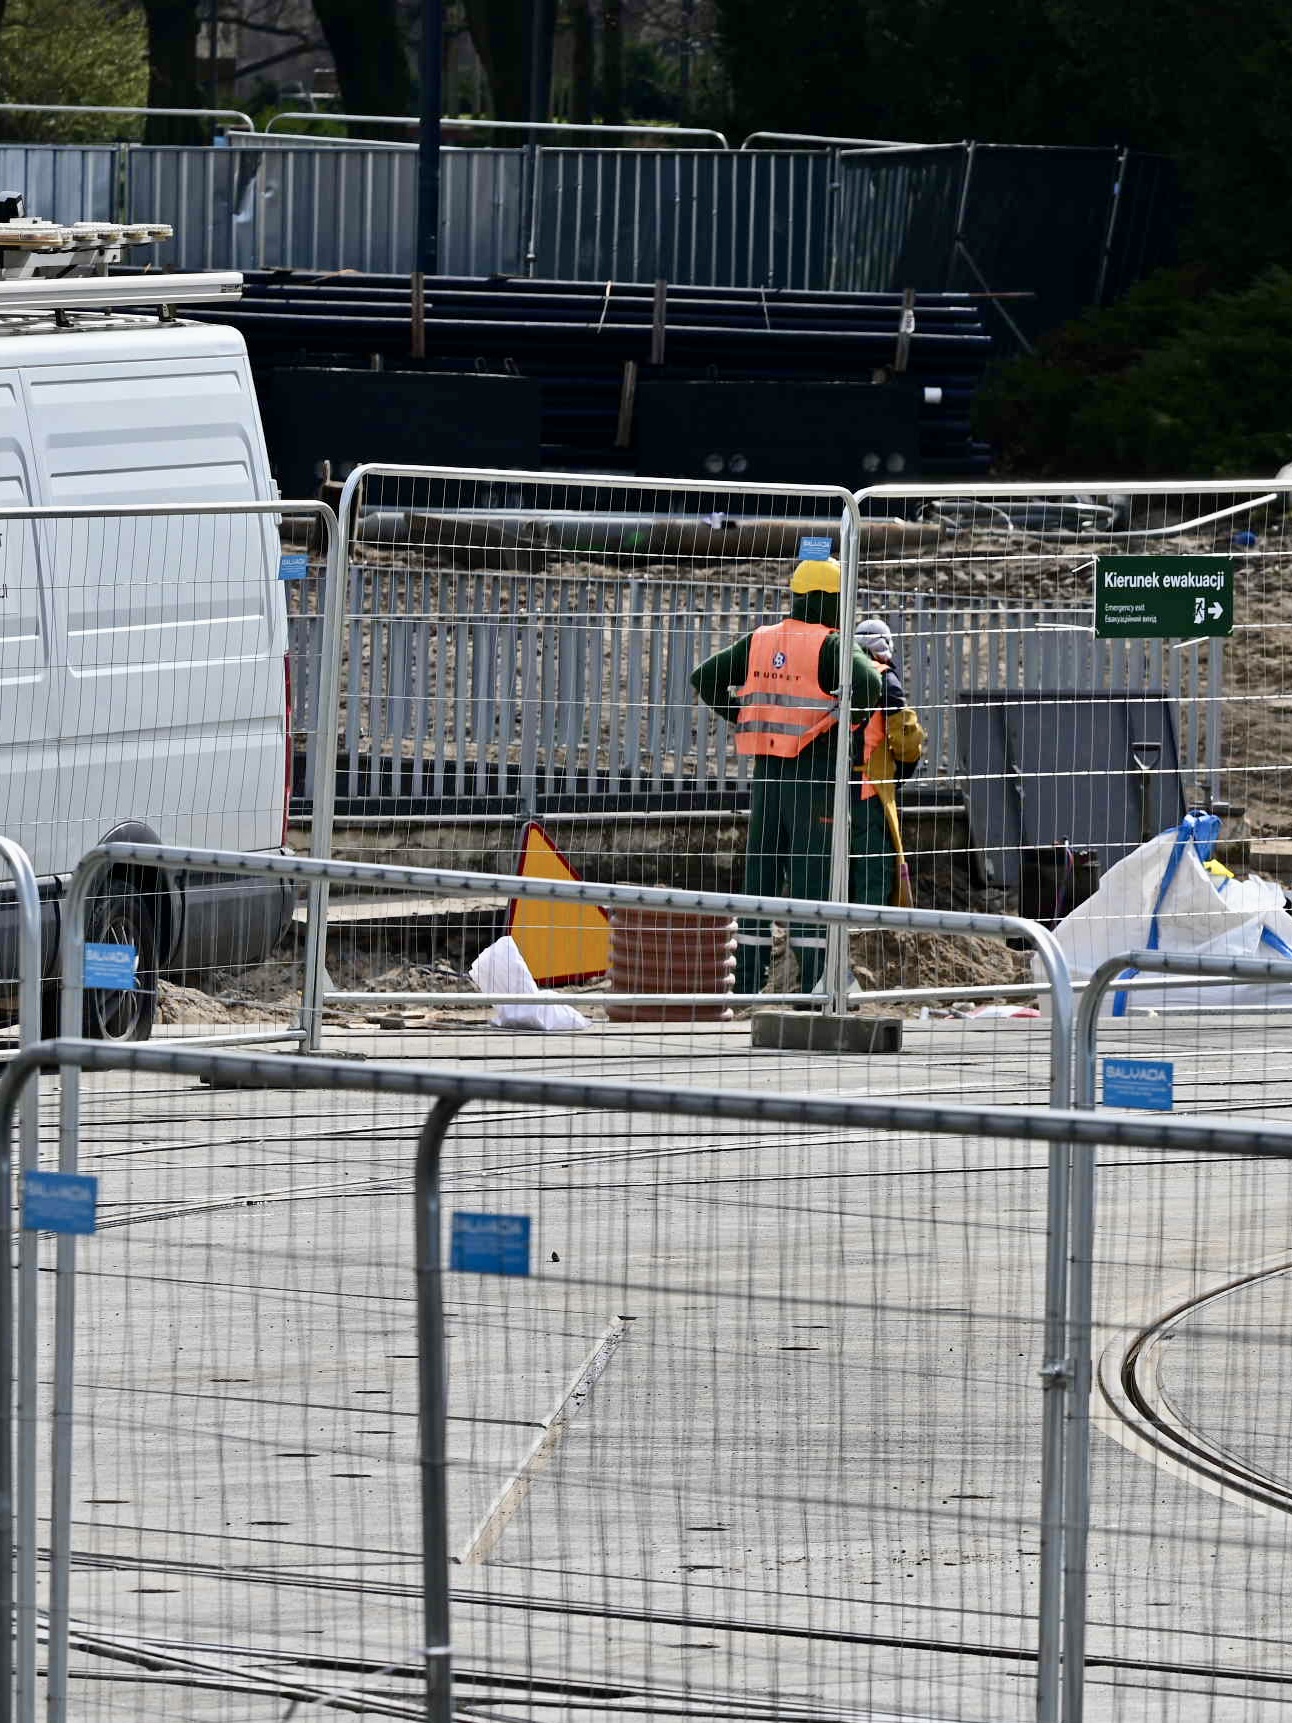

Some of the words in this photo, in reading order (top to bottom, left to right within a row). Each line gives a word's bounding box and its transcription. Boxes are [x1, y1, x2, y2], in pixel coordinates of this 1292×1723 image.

[1104, 571, 1160, 588] Kierunek
[1163, 571, 1225, 591] ewakuacji
[1105, 603, 1134, 613] Emergency
[1135, 604, 1146, 612] exit
